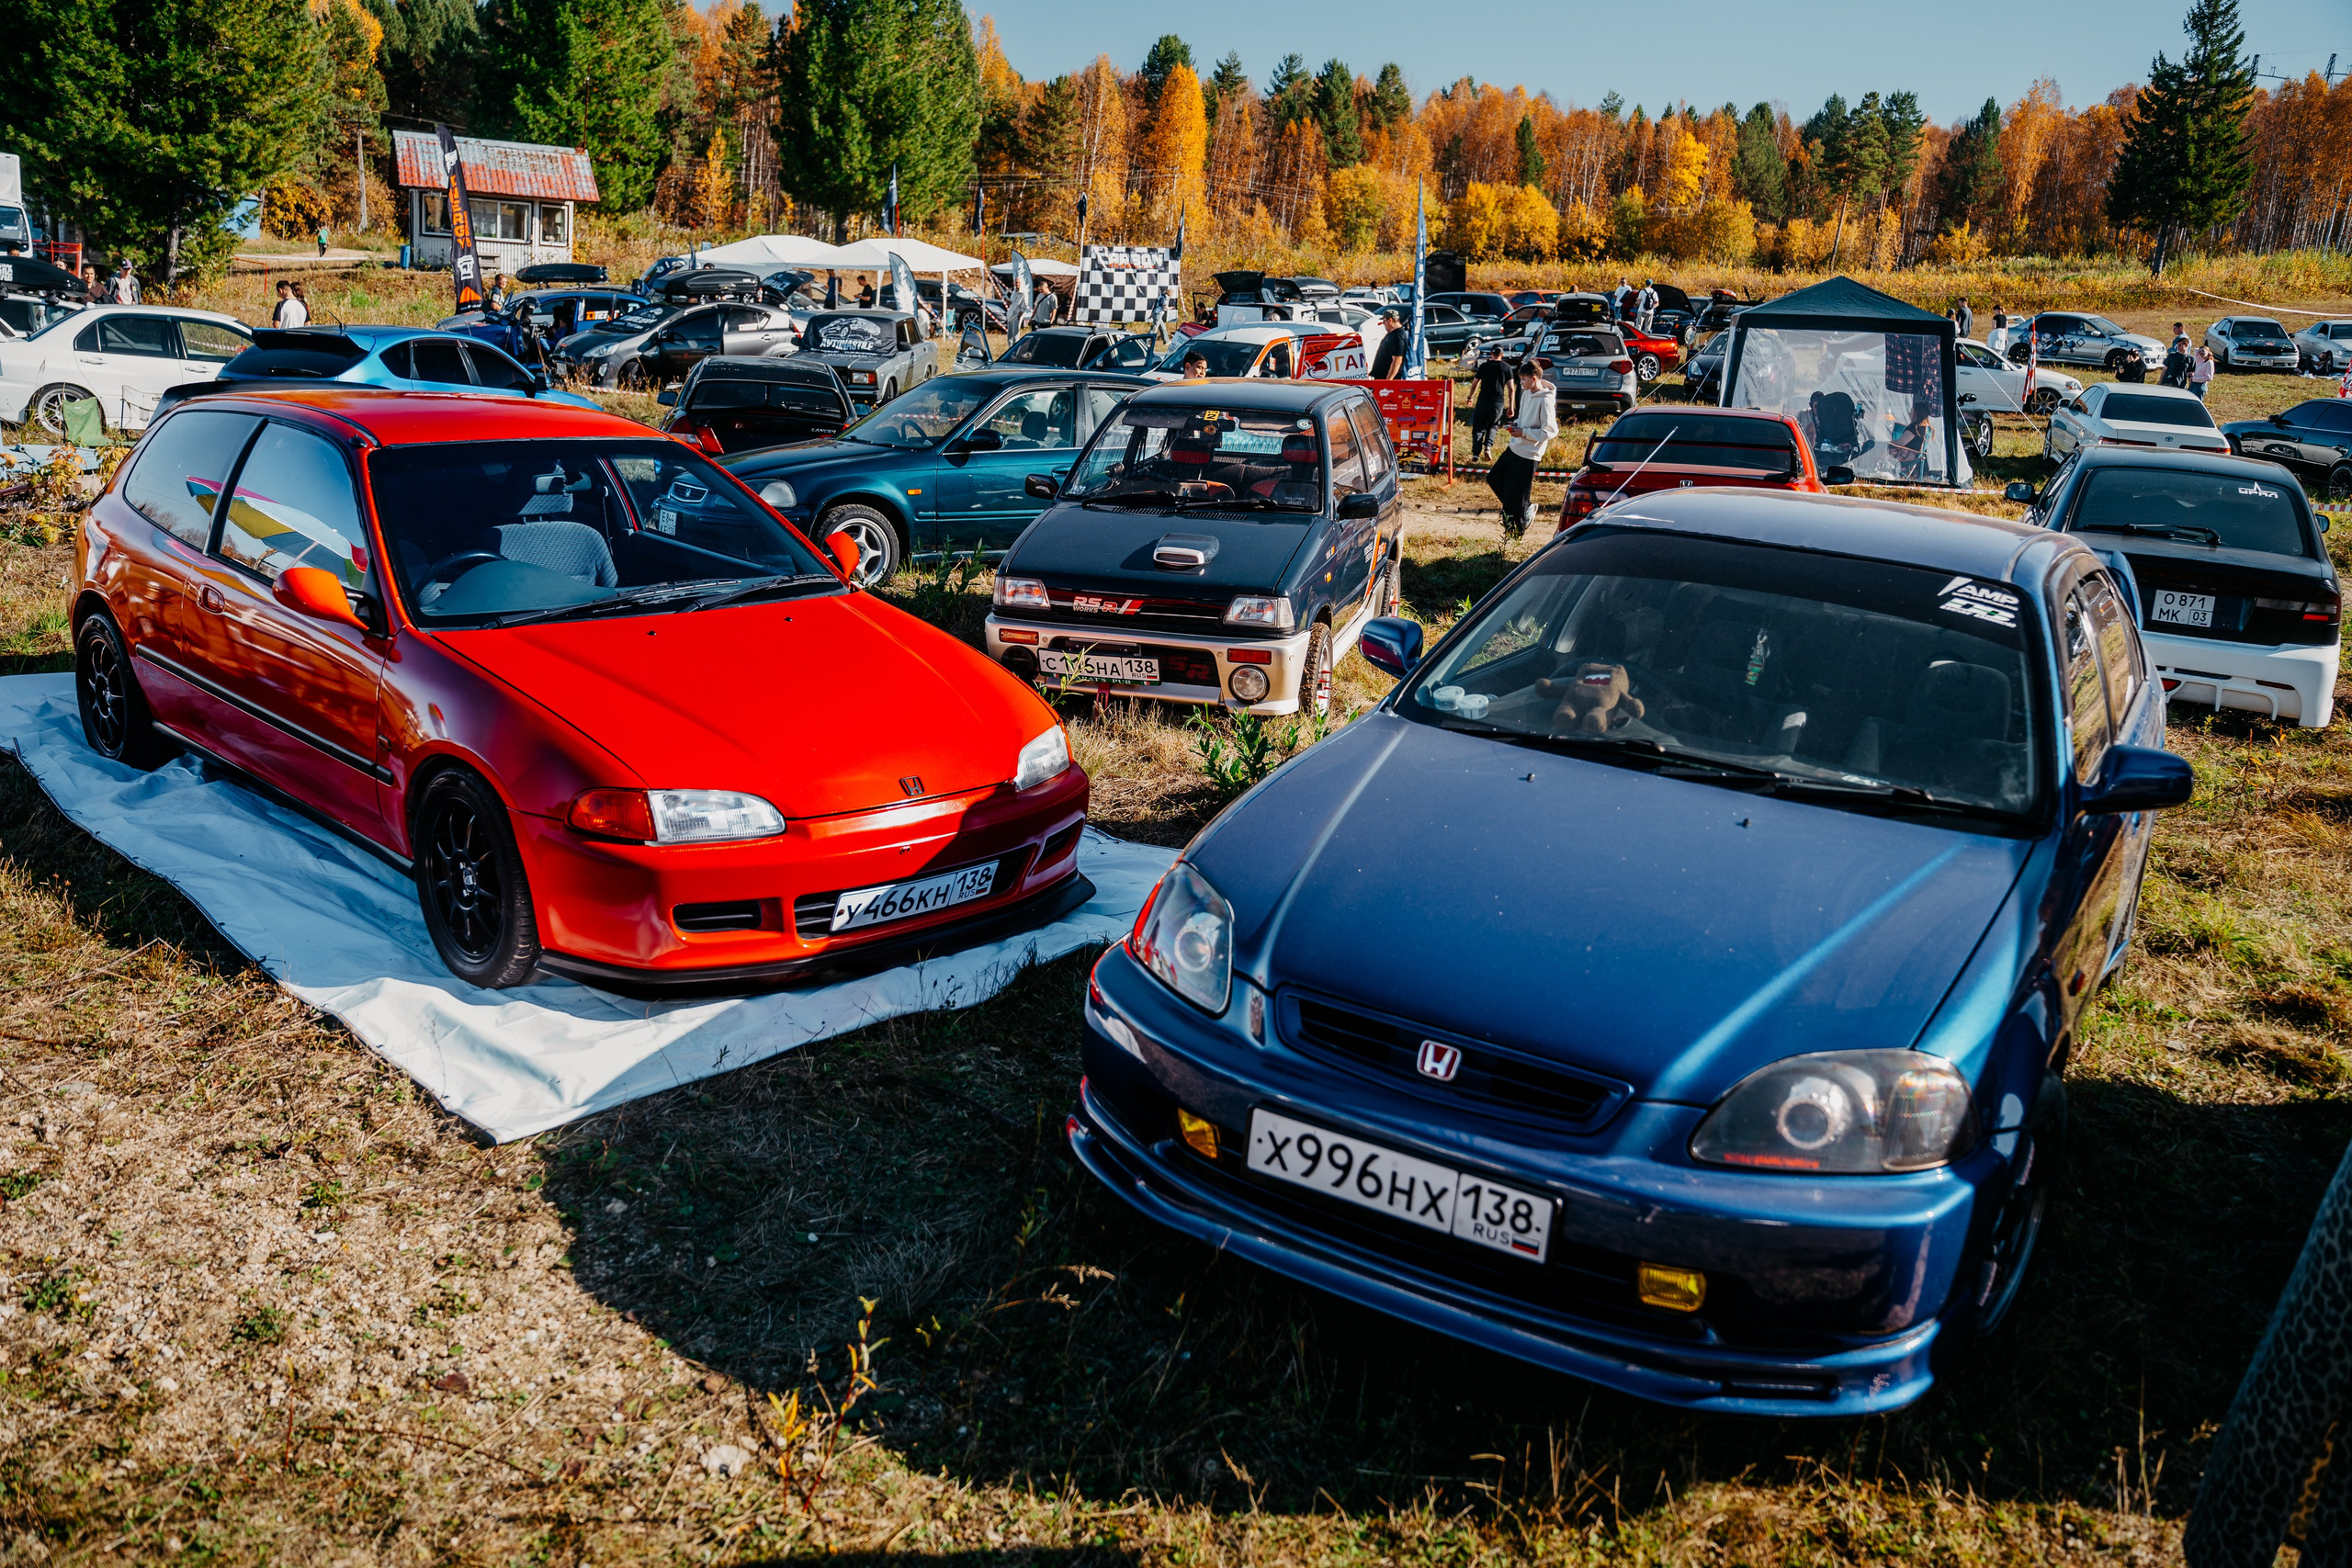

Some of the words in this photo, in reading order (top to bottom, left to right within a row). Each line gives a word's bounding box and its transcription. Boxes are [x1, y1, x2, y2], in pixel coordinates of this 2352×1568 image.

[1956, 584, 2019, 605] AMP
[2158, 607, 2181, 622] МК
[2192, 611, 2207, 622] 03
[1124, 659, 1155, 674] 138
[846, 884, 951, 925] У466КН
[956, 866, 992, 891] 138
[957, 887, 977, 901] RUS
[1264, 1130, 1449, 1224] Х996НХ
[1462, 1184, 1533, 1235] 138
[1473, 1223, 1510, 1246] RUS
